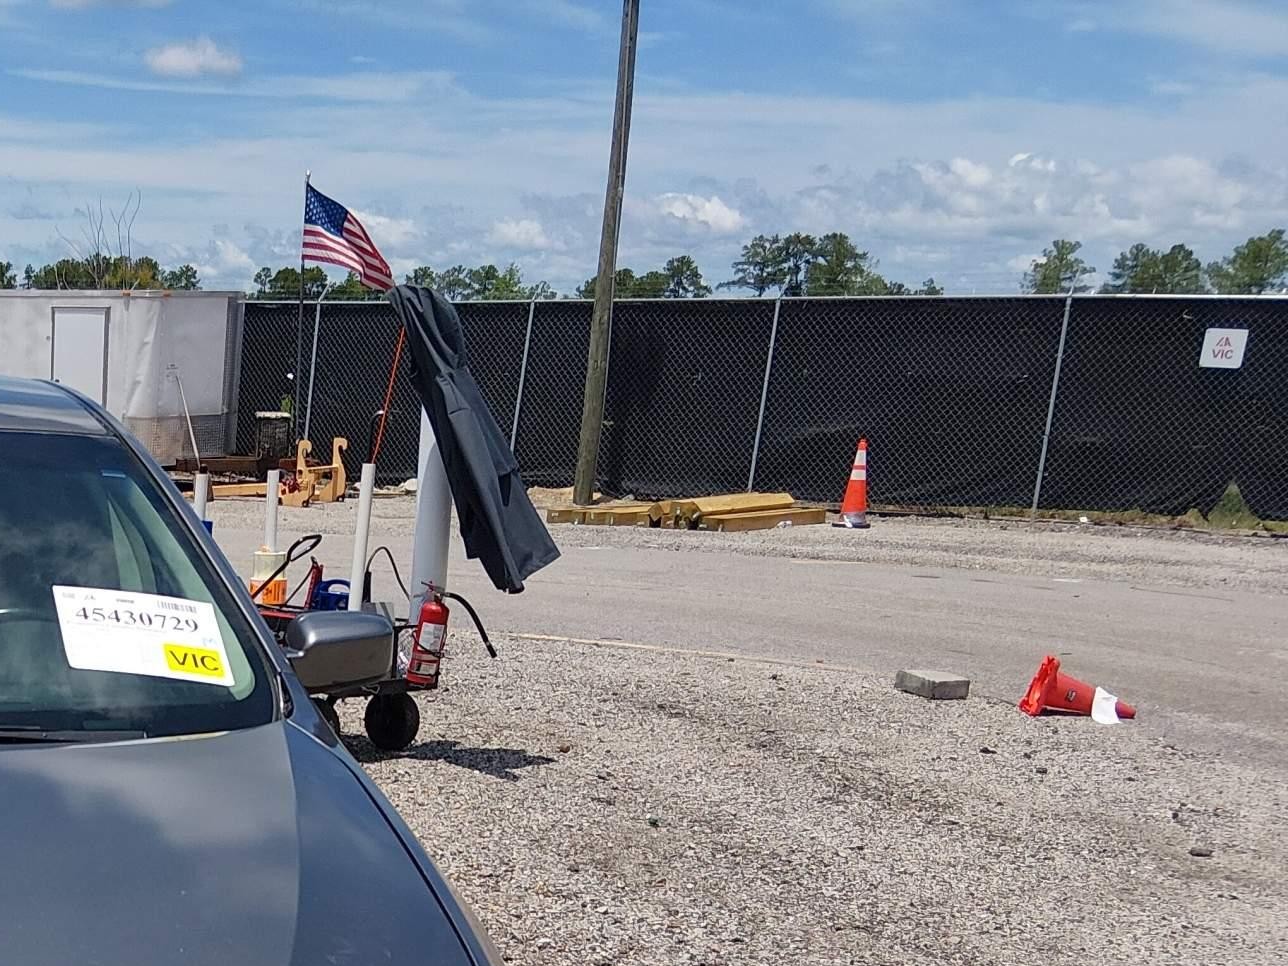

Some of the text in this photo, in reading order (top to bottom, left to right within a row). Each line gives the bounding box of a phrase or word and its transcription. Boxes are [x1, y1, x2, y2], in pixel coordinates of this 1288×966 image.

[1212, 349, 1234, 360] VIC
[75, 606, 199, 633] 45430729
[169, 649, 220, 672] VIC
